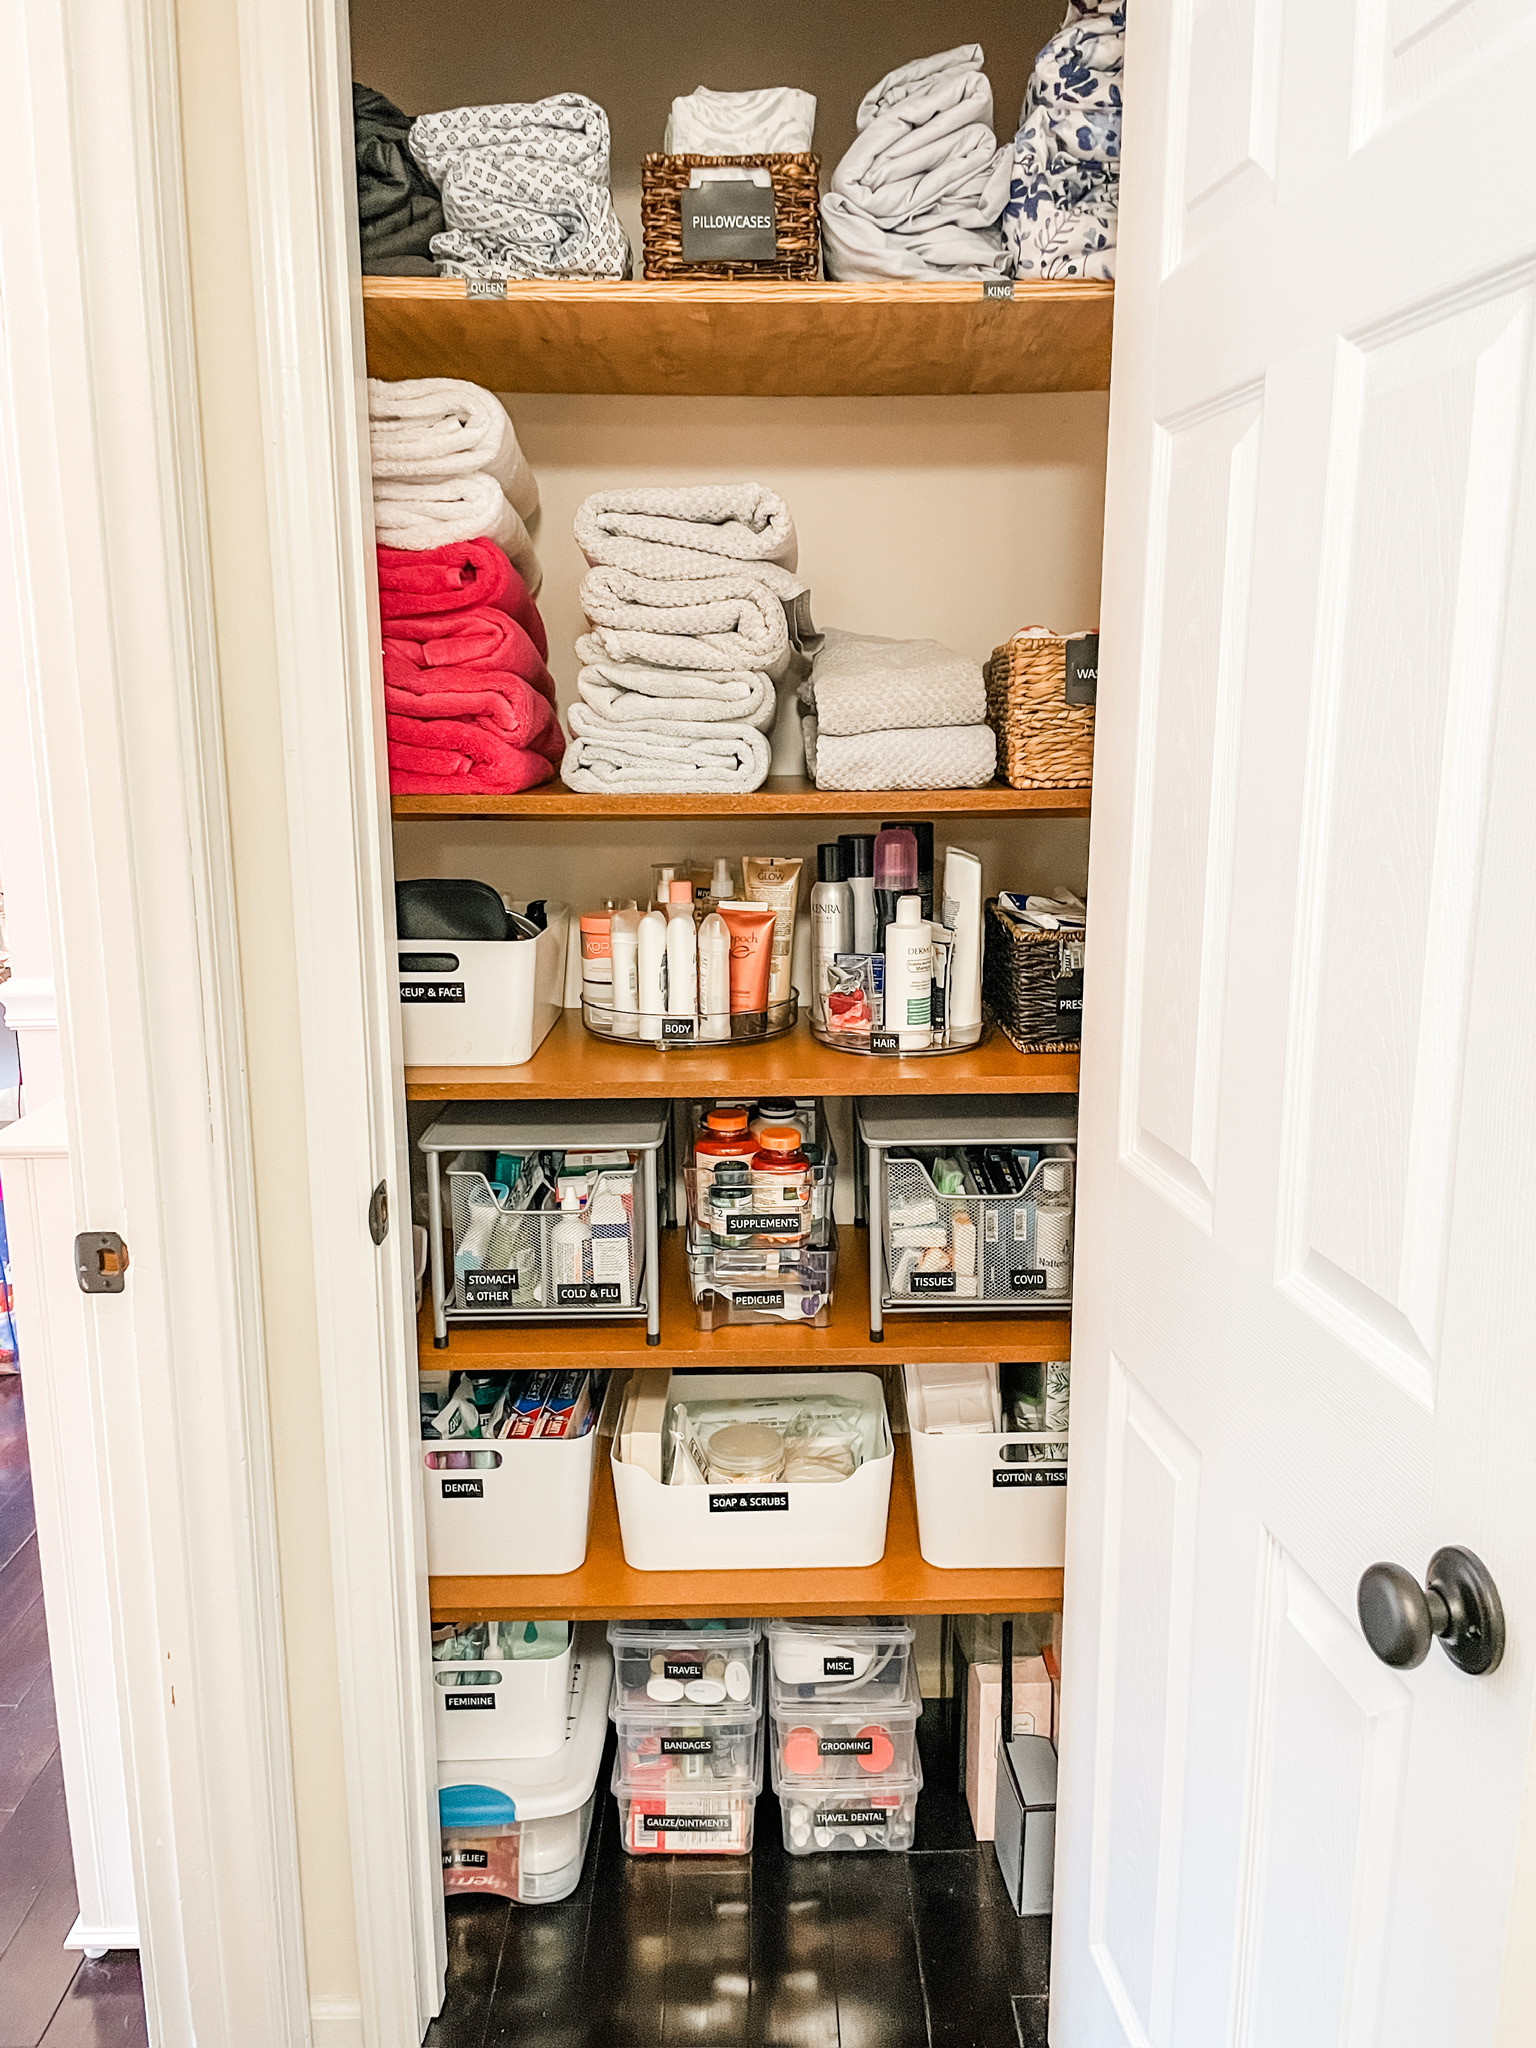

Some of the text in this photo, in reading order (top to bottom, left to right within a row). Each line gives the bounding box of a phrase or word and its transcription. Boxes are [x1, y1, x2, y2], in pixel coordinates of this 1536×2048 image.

[692, 215, 771, 229] PILLOWCASES
[471, 282, 504, 295] QUEEN
[987, 286, 1011, 297] KING
[757, 872, 785, 881] GLOW
[731, 931, 758, 947] poch
[427, 987, 437, 997] &
[438, 987, 463, 997] FACE
[664, 1024, 692, 1034] BODY
[873, 1038, 897, 1049] HAIR
[730, 1218, 799, 1229] SUPPLEMENTS
[468, 1274, 516, 1285] STOMACH
[914, 1277, 954, 1287] TISSUES
[1013, 1274, 1044, 1285] COVID
[466, 1291, 510, 1301] & OTHER
[561, 1288, 619, 1299] COLD & FLU
[735, 1294, 782, 1305] PEDICURE
[996, 1472, 1067, 1482] COTTON & TISS
[444, 1483, 482, 1493] DENTAL
[712, 1497, 787, 1508] SOAP & SCRUBS
[667, 1665, 701, 1674] TRAVEL
[826, 1662, 852, 1671] MISC.
[448, 1697, 493, 1706] FEMININE
[664, 1741, 711, 1750] BANDAGES
[821, 1741, 871, 1750] GROOMING
[646, 1817, 729, 1828] GAUZE/OINTMENTS
[816, 1812, 885, 1823] TRAVEL DENTAL
[454, 1853, 485, 1863] RELIEF
